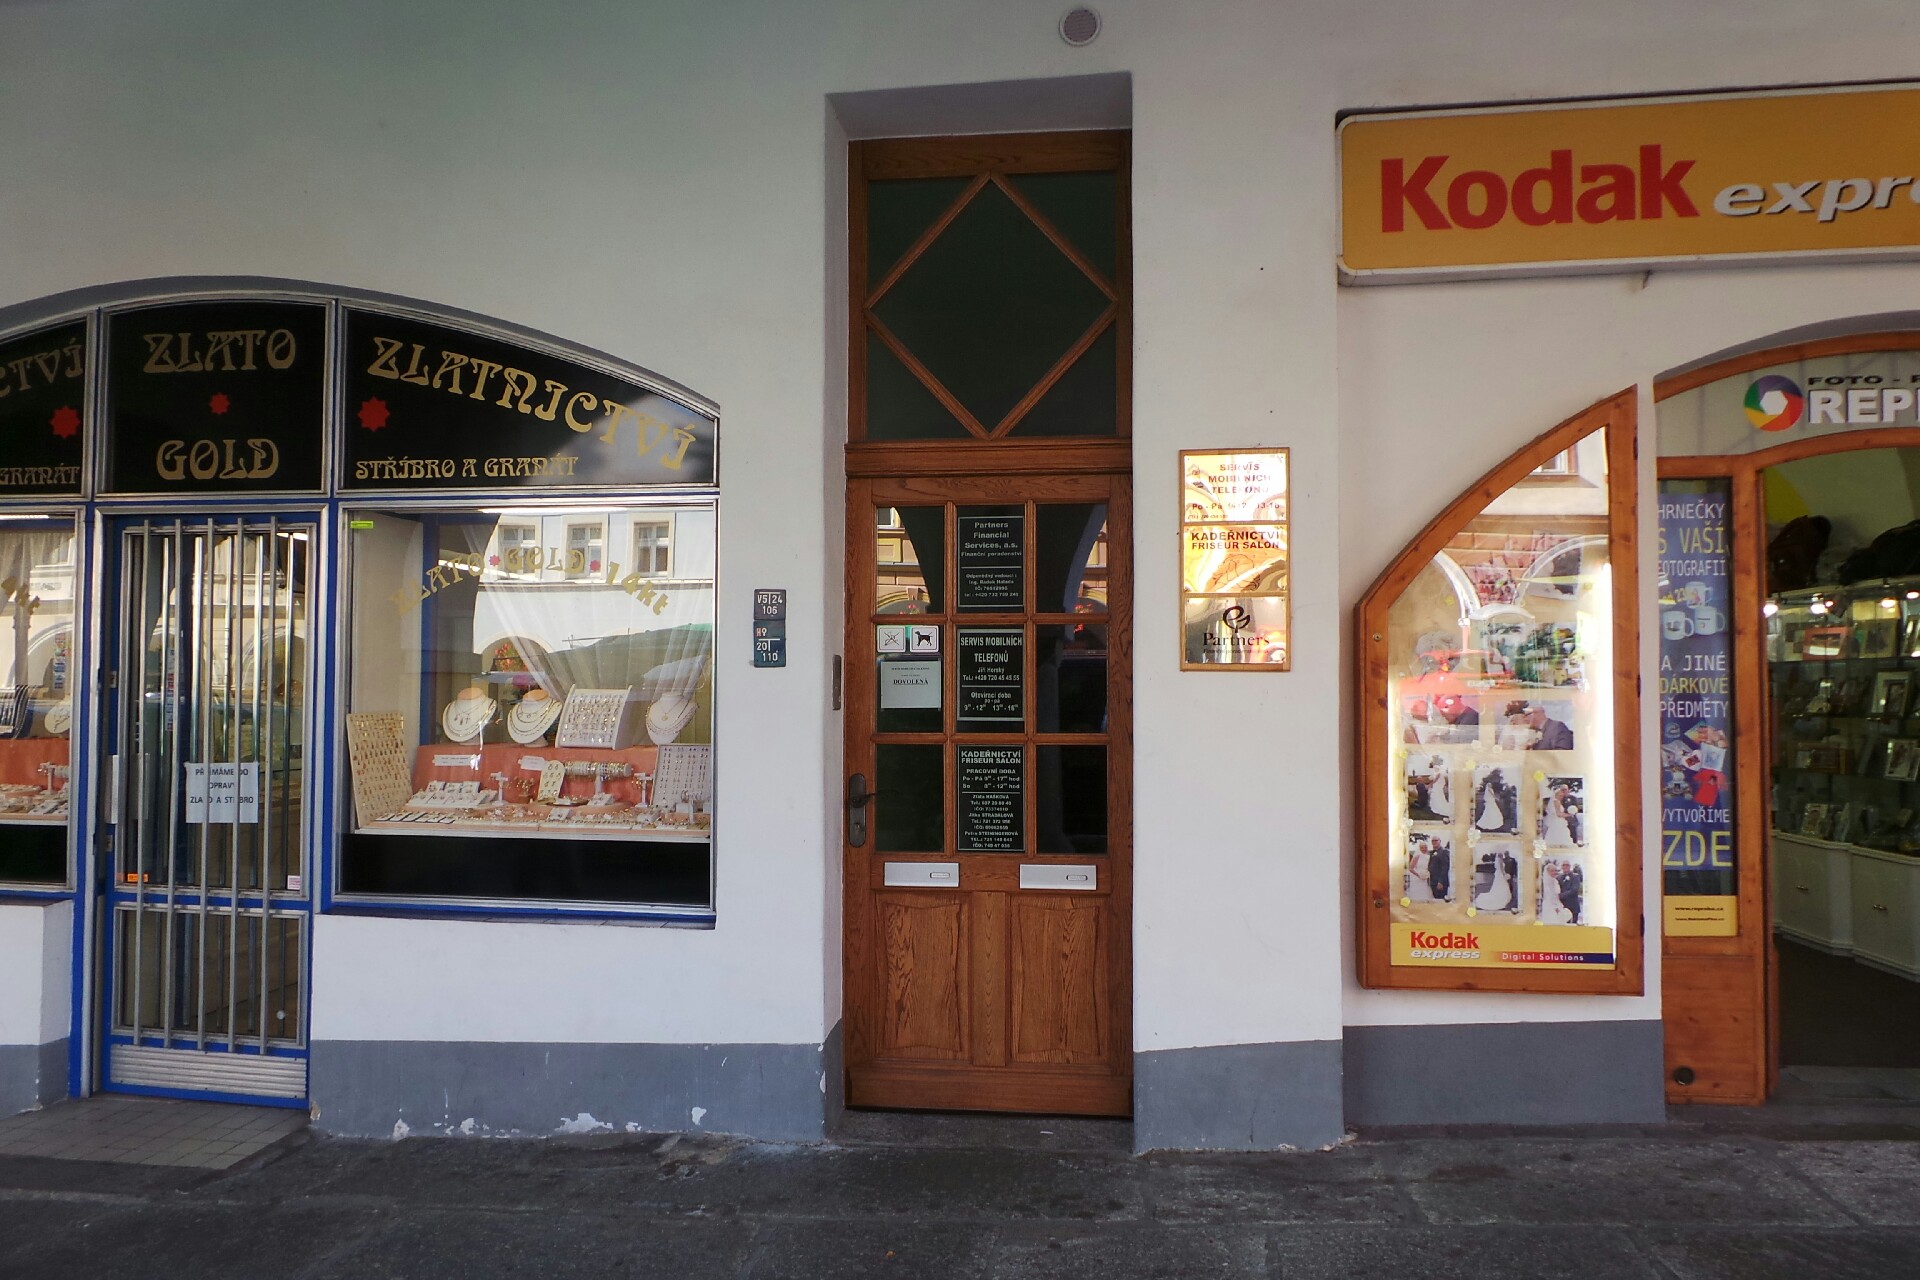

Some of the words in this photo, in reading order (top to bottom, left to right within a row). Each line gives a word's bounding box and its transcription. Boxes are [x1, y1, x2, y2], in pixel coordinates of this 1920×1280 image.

[1381, 144, 1700, 233] Kodak
[1713, 175, 1920, 223] expr
[143, 328, 297, 373] ZLATO
[1808, 375, 1883, 385] FOTO
[367, 336, 697, 471] ZLATNICTVÍ
[1808, 388, 1920, 424] REP
[156, 438, 280, 481] GOLD
[355, 456, 454, 480] STŘÍBRO
[462, 458, 478, 478] A
[484, 453, 579, 477] GRANÁT
[1192, 541, 1239, 550] FRISEUR
[1242, 541, 1280, 549] SALON
[1679, 520, 1727, 554] VAŠÍ
[505, 546, 585, 574] GOLD
[960, 637, 984, 646] SERVIS
[985, 635, 1023, 646] MOBILNÍCH
[1203, 632, 1270, 646] Partners
[974, 649, 1009, 662] TELEFONŮ
[1661, 655, 1672, 671] A
[1683, 651, 1726, 671] JINÉ
[893, 677, 929, 685] DOVOLENÁ
[1660, 674, 1729, 694] DÁRKOVÉ
[1660, 696, 1729, 718] PŘEDMĚTY
[961, 750, 1021, 758] KADEŘNICTVÍ
[1662, 830, 1732, 867] ZDE
[1410, 931, 1479, 949] Kodak
[1410, 949, 1480, 960] express
[1502, 952, 1535, 962] Digital
[1539, 953, 1584, 962] Solutions
